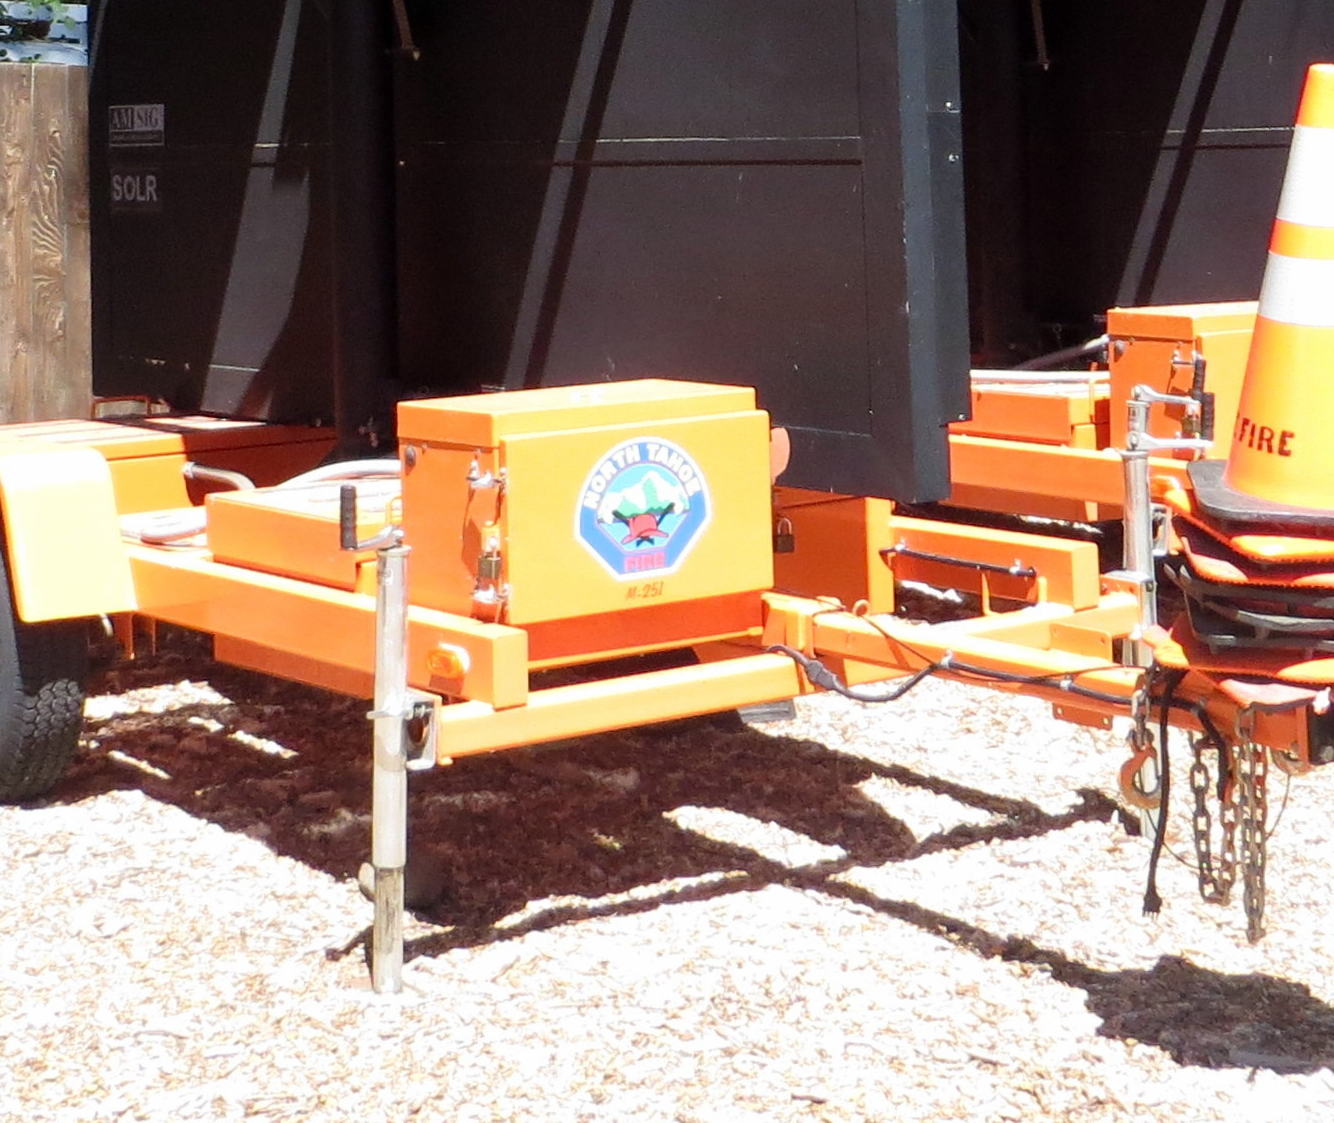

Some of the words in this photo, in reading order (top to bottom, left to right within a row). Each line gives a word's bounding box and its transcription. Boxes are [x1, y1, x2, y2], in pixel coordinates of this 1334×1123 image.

[112, 174, 157, 202] SOLR
[1239, 417, 1295, 457] FIRE
[583, 445, 641, 509] NORTH
[646, 443, 702, 497] TAHOE
[624, 552, 665, 572] FIRE
